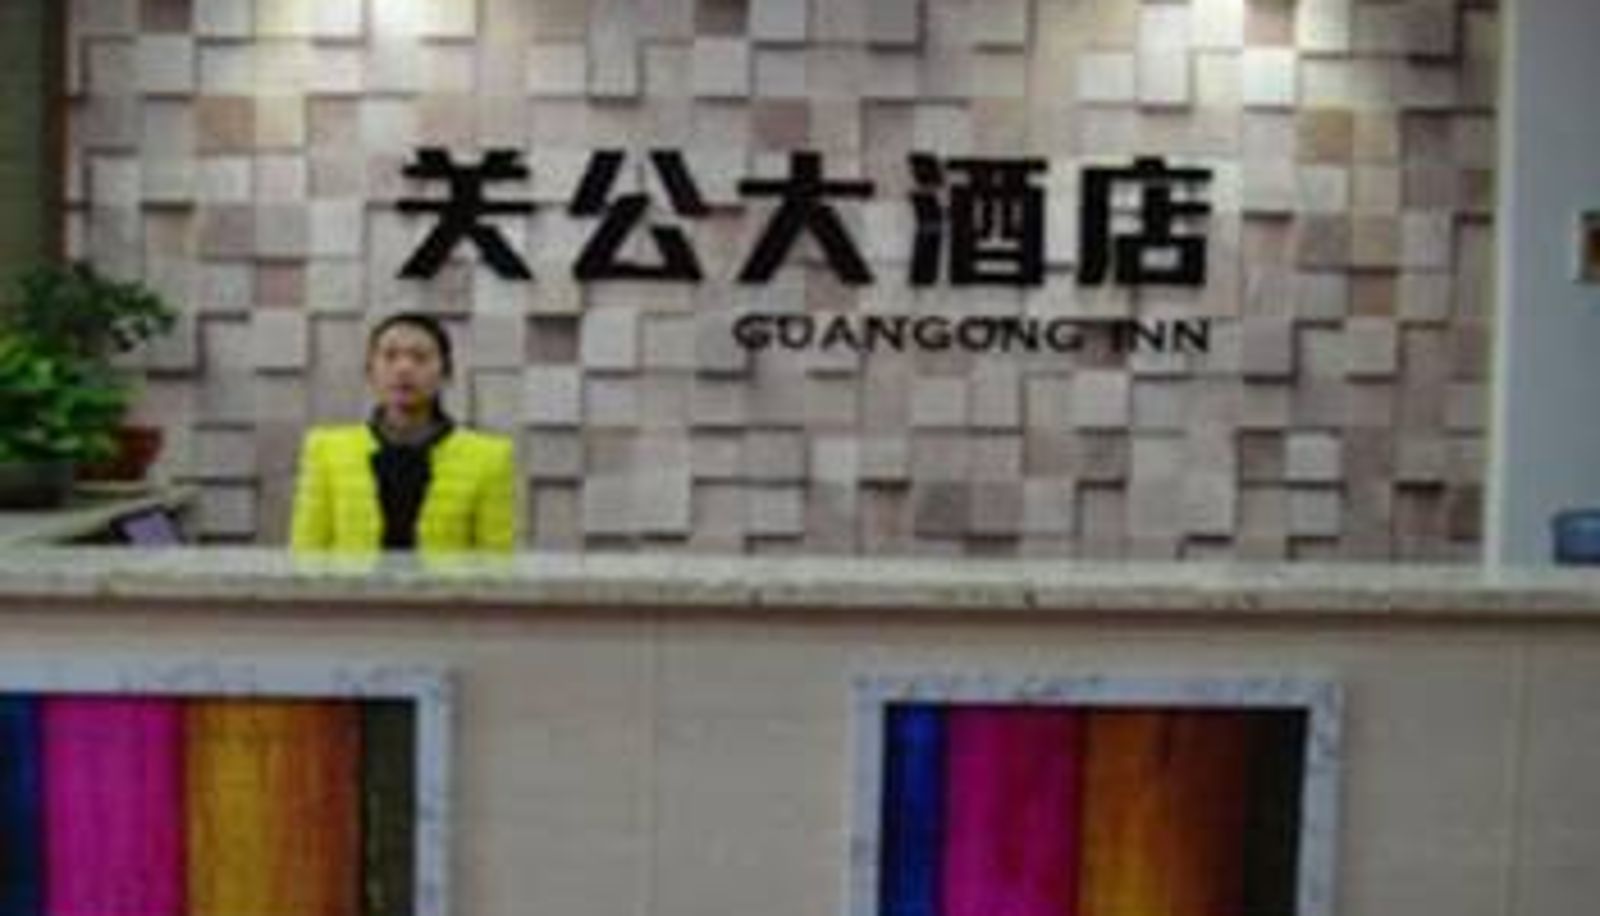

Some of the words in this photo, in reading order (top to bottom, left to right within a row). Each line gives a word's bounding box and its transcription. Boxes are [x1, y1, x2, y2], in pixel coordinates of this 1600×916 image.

[396, 149, 1212, 288] 关公大酒店
[732, 314, 1084, 354] GUANGONG
[1110, 317, 1211, 355] INN
